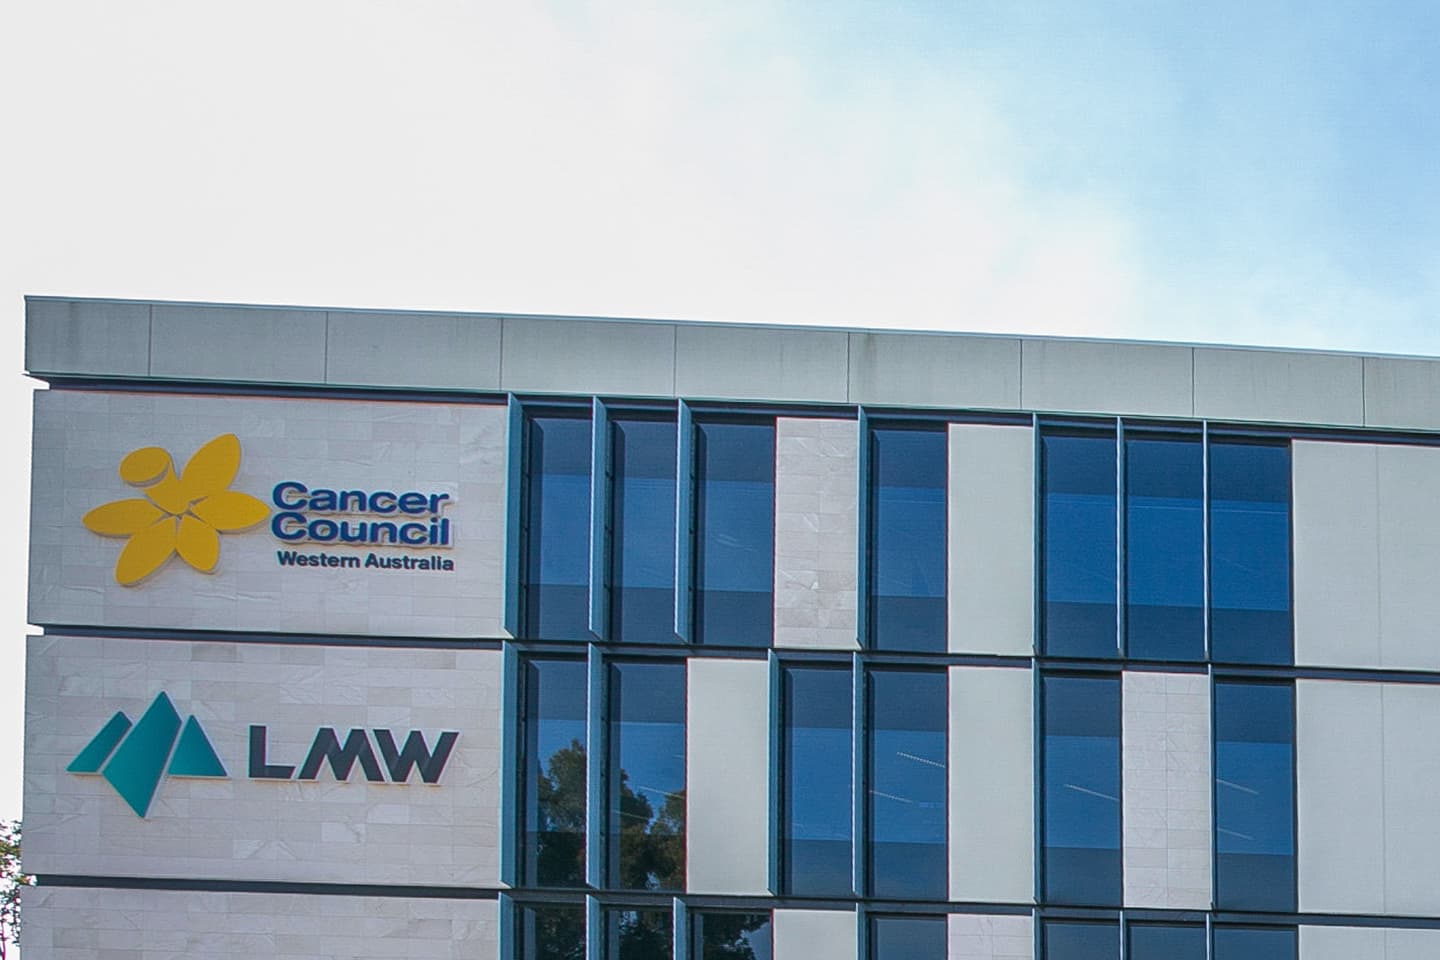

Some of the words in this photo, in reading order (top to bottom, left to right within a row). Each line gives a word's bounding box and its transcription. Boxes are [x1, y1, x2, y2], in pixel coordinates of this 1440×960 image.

[272, 481, 450, 514] Cancer
[271, 511, 450, 545] Council
[277, 550, 360, 568] Western
[364, 552, 454, 571] Australia
[249, 725, 459, 784] LMW
